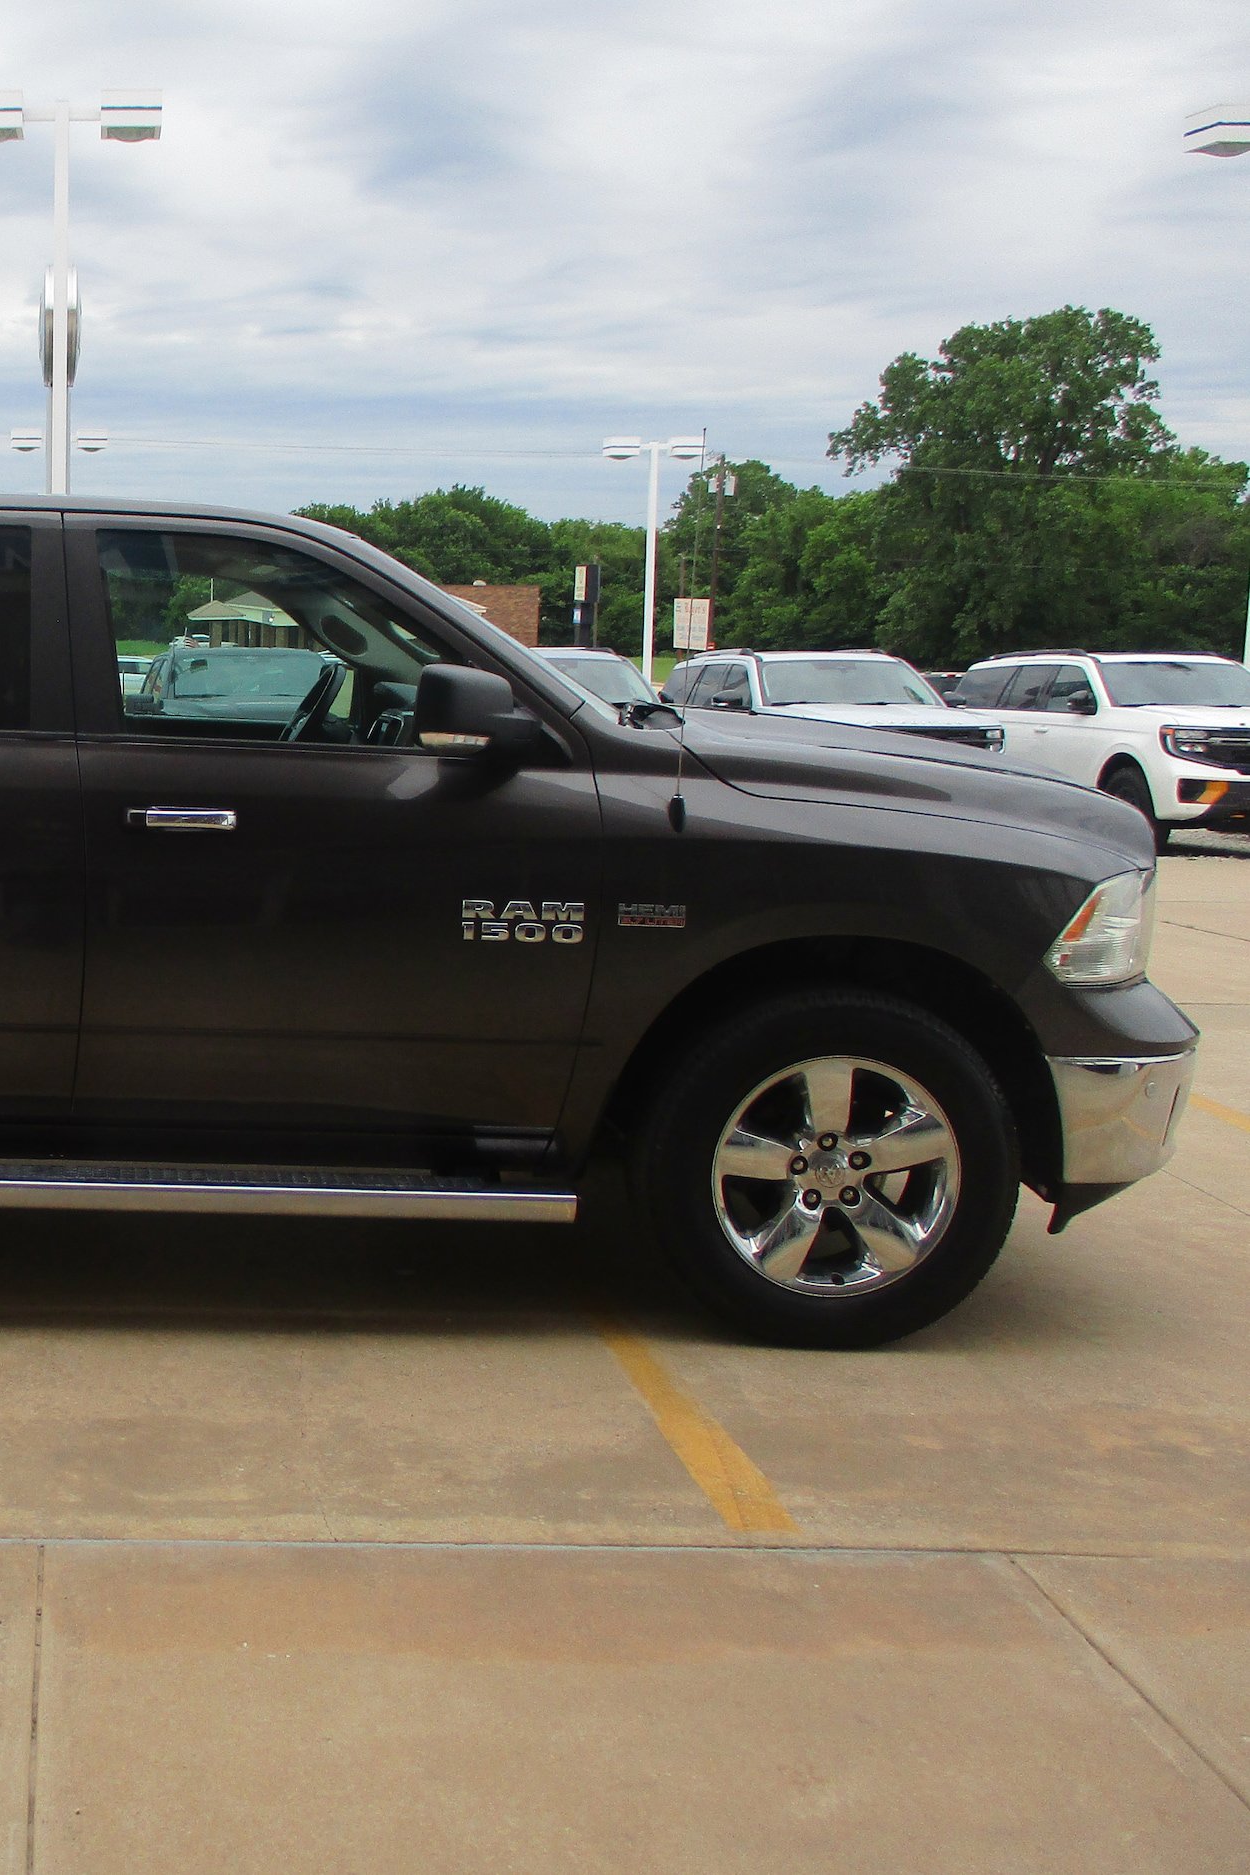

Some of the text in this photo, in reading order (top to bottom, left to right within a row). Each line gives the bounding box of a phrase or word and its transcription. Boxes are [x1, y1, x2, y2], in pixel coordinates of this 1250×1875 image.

[462, 899, 585, 921] RAM
[618, 903, 686, 916] HEMI
[462, 922, 584, 943] 1500
